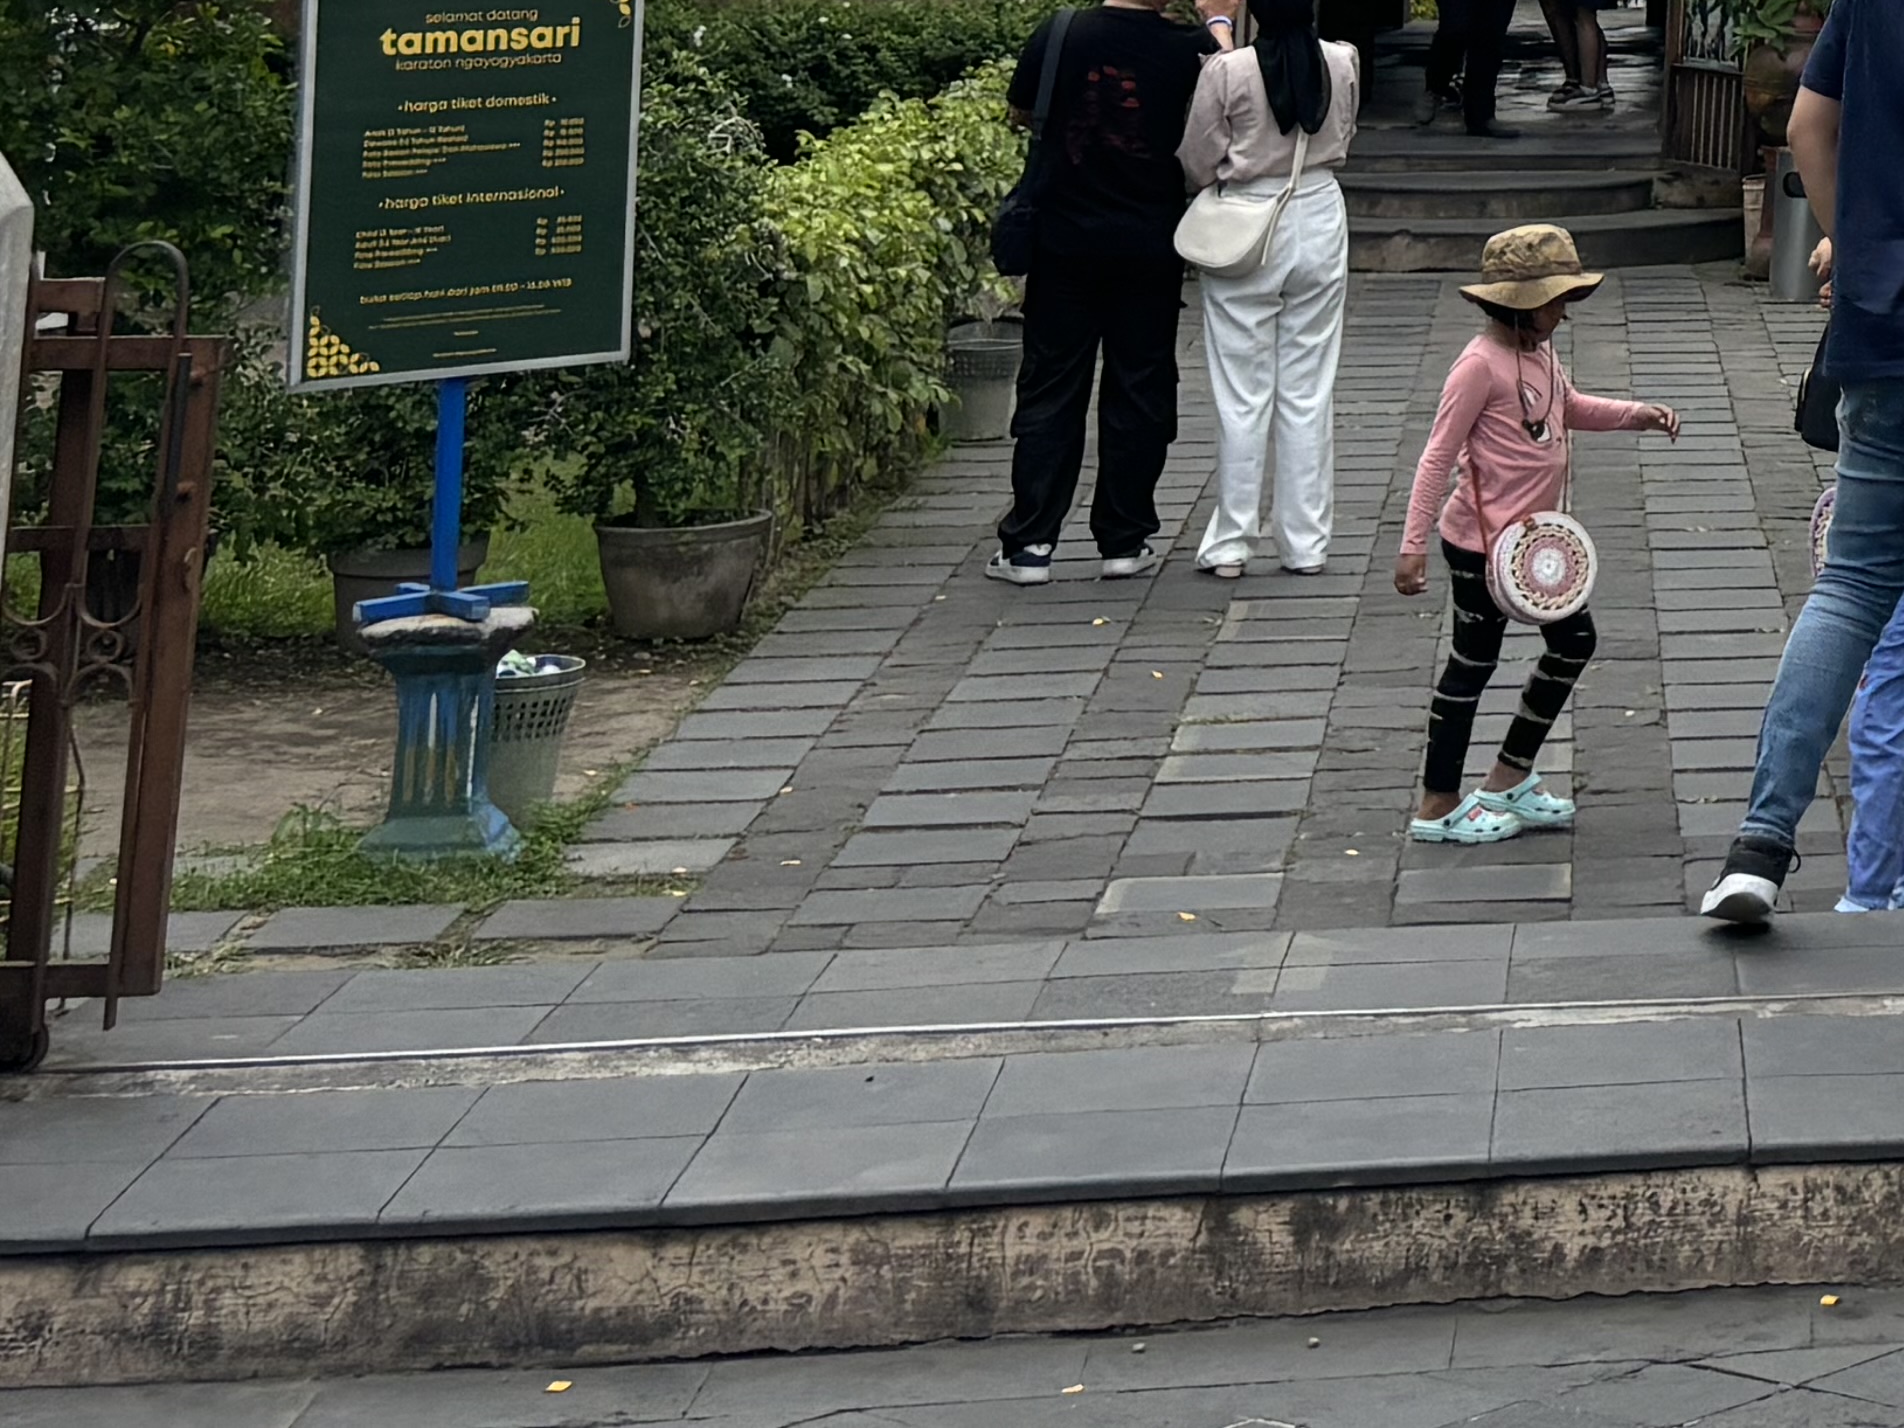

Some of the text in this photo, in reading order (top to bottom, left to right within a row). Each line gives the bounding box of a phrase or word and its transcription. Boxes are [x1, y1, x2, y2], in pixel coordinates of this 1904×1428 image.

[425, 9, 538, 24] selamat datang
[379, 16, 581, 56] tamansari
[395, 52, 562, 71] karaton ngayogyakarta
[404, 92, 550, 114] harga tiket domestik
[384, 193, 429, 211] harga
[432, 192, 464, 207] tiket
